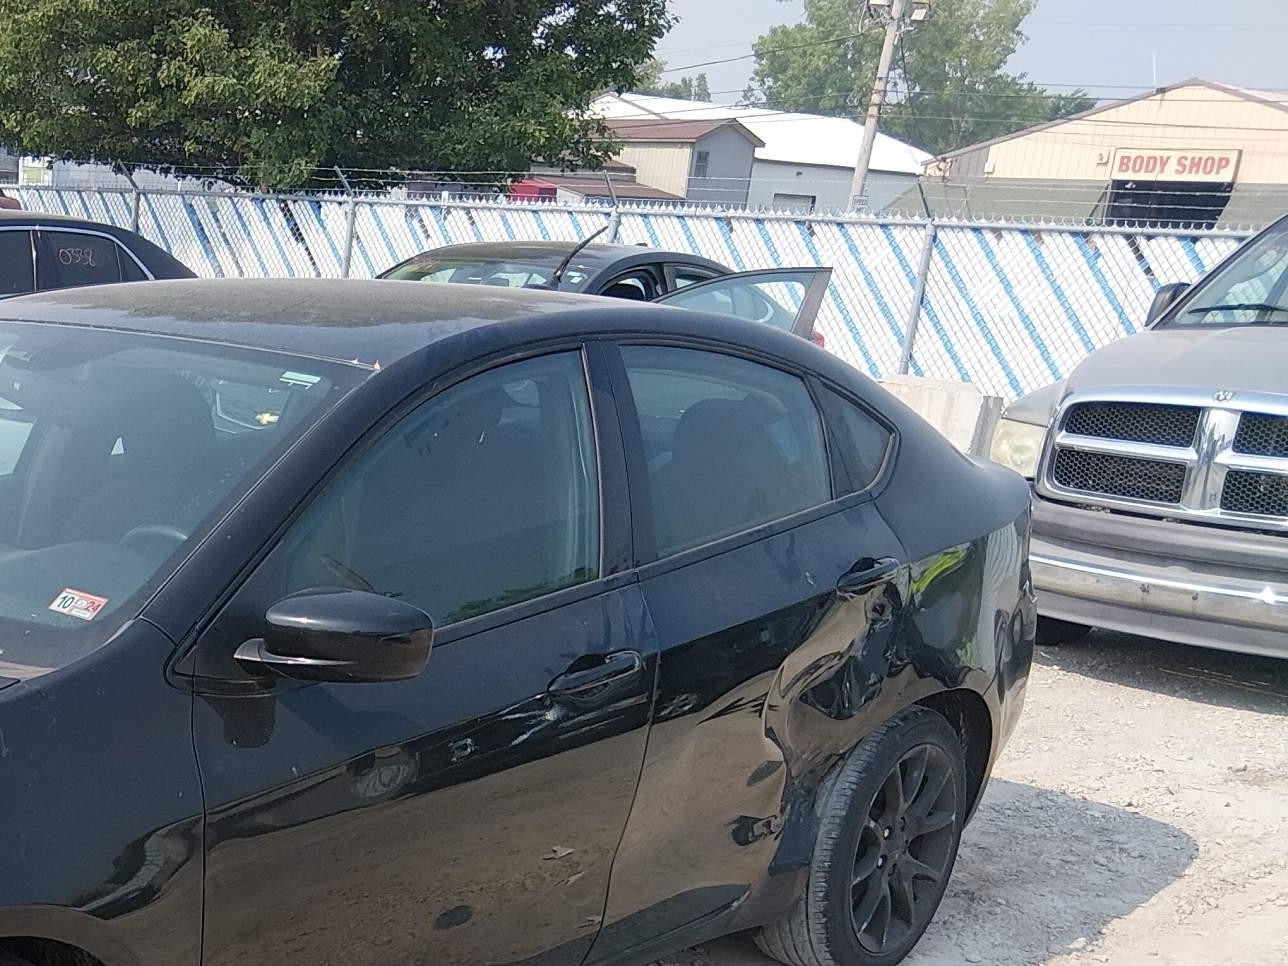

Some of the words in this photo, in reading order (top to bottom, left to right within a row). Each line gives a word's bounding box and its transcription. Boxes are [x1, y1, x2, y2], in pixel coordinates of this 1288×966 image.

[1117, 155, 1171, 174] BODY
[1174, 155, 1231, 175] SHOP
[57, 594, 76, 609] 10
[85, 601, 103, 613] 24
